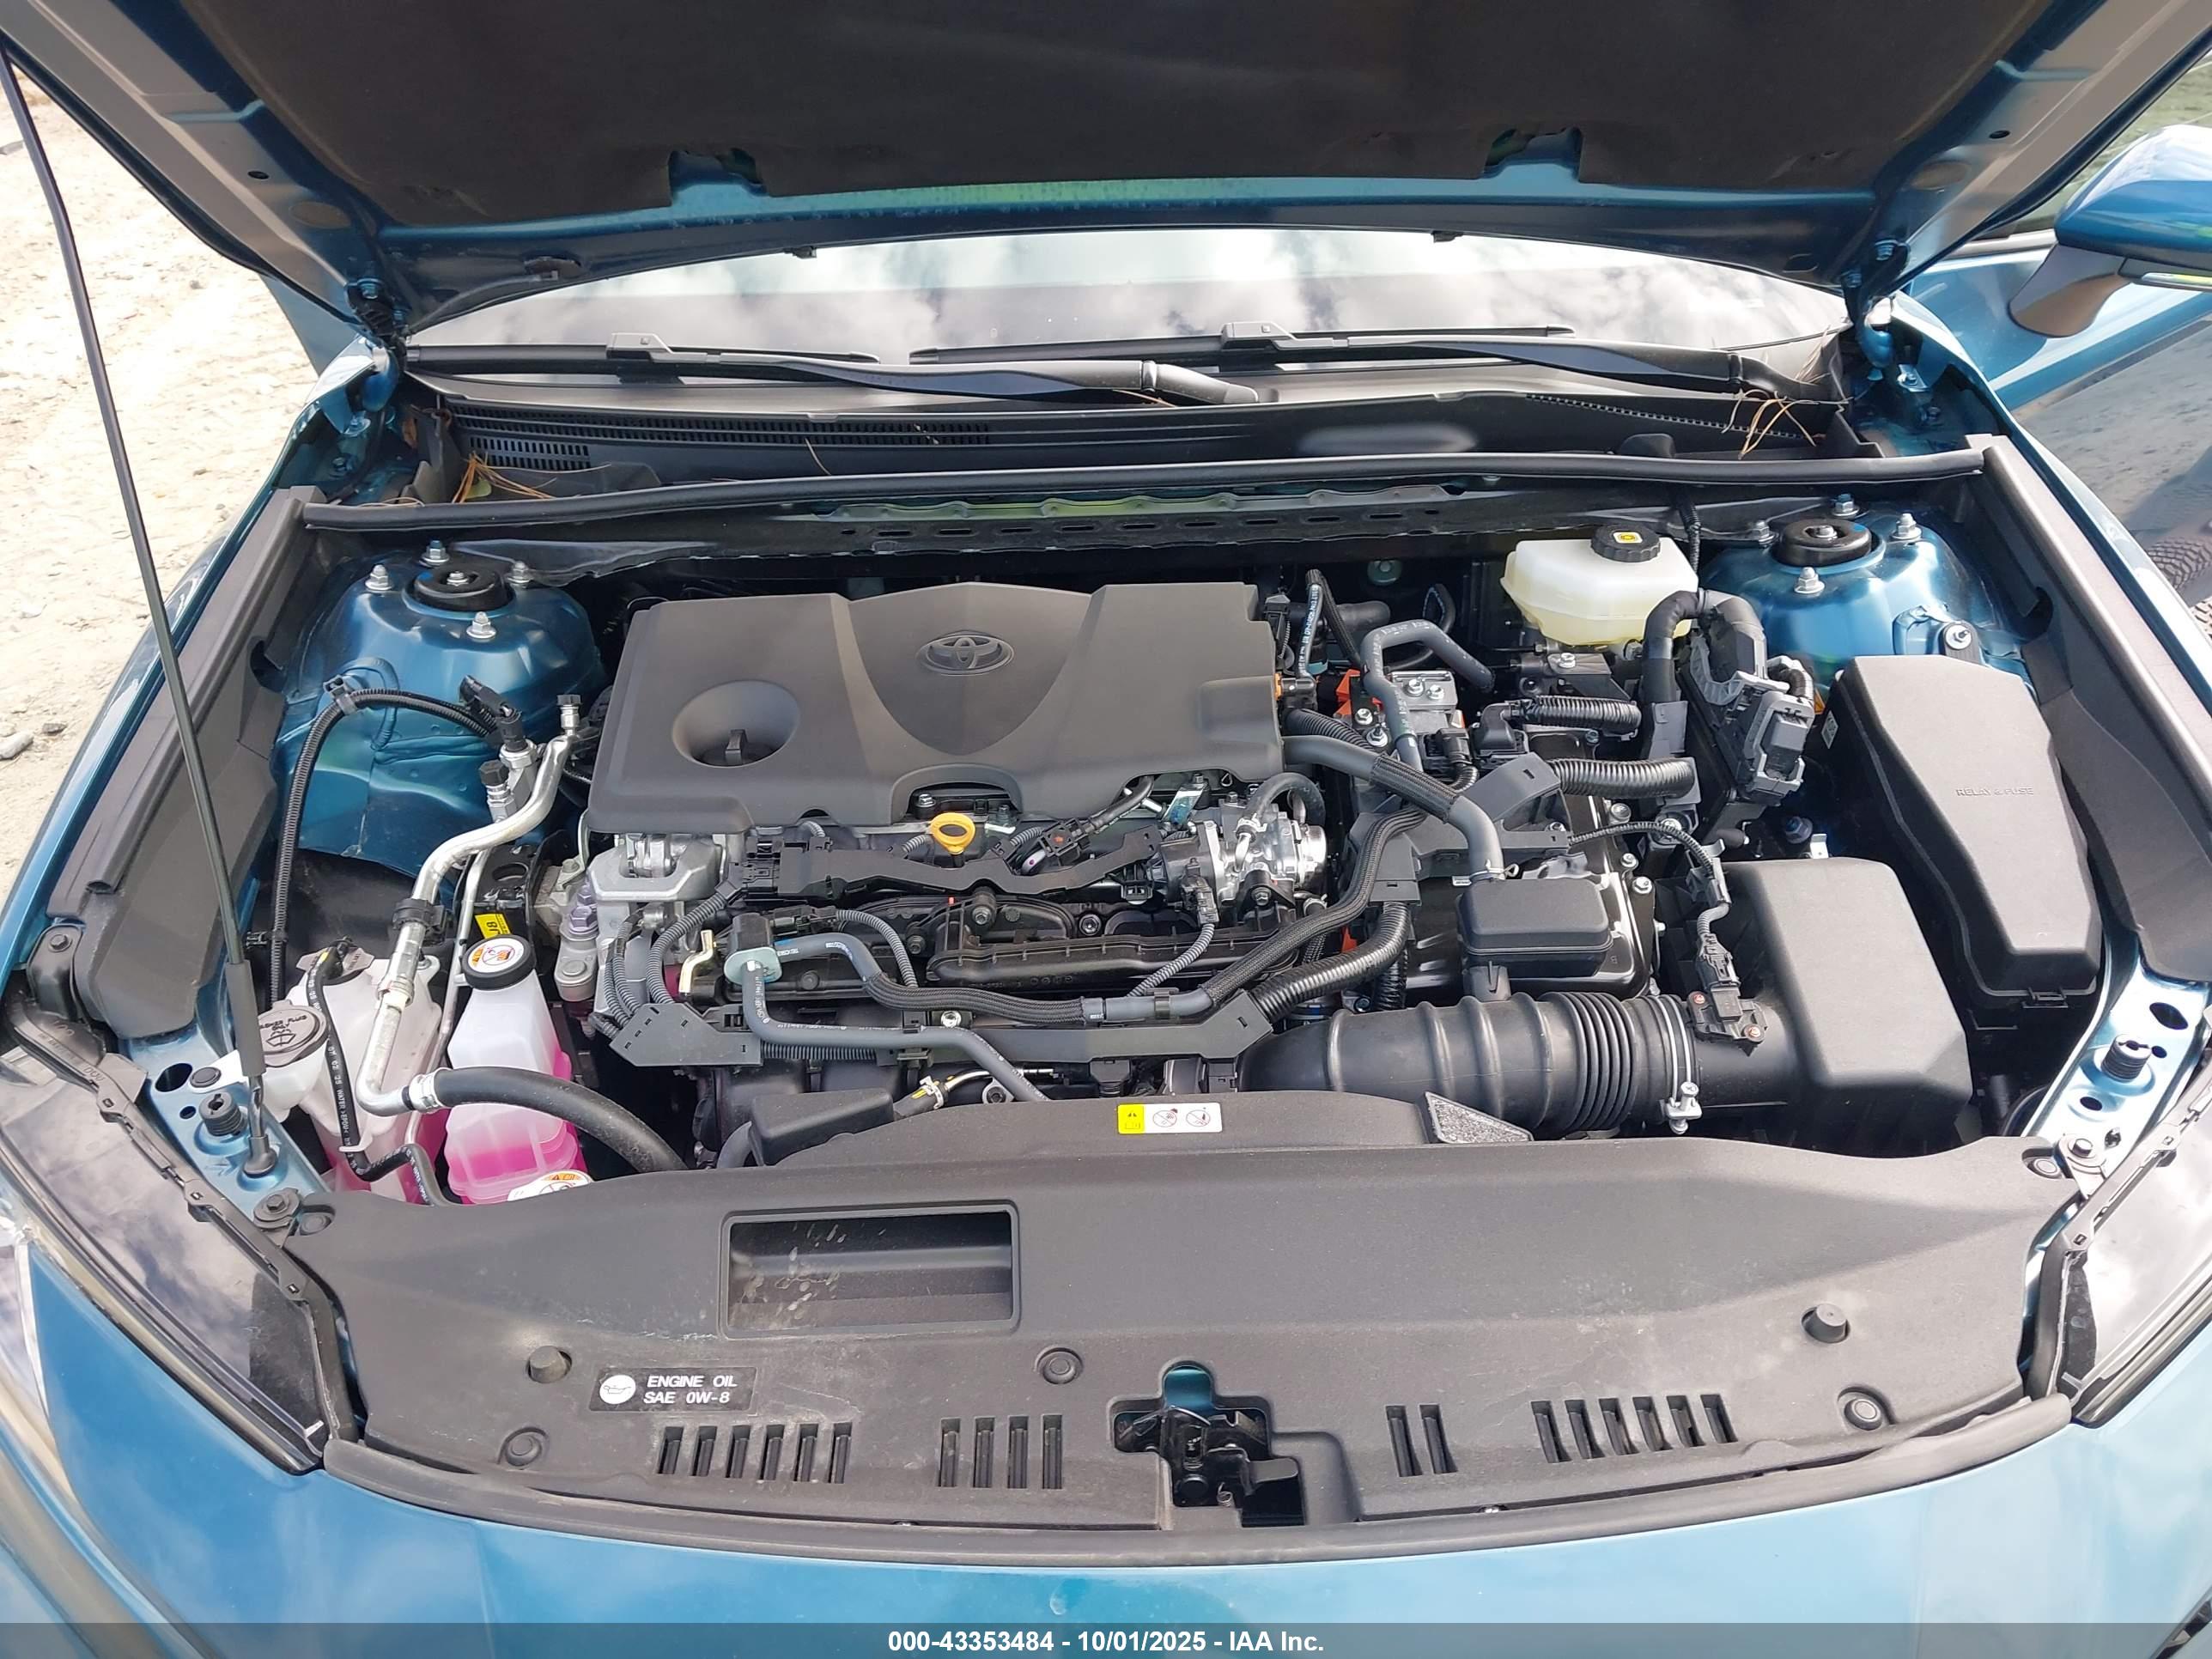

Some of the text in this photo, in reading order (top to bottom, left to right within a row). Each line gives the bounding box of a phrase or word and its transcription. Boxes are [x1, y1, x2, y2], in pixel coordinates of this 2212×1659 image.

[1956, 788, 1992, 797] RELAY
[647, 1376, 737, 1387] ENGINE OIL
[644, 1391, 730, 1403] SAE 0W-8
